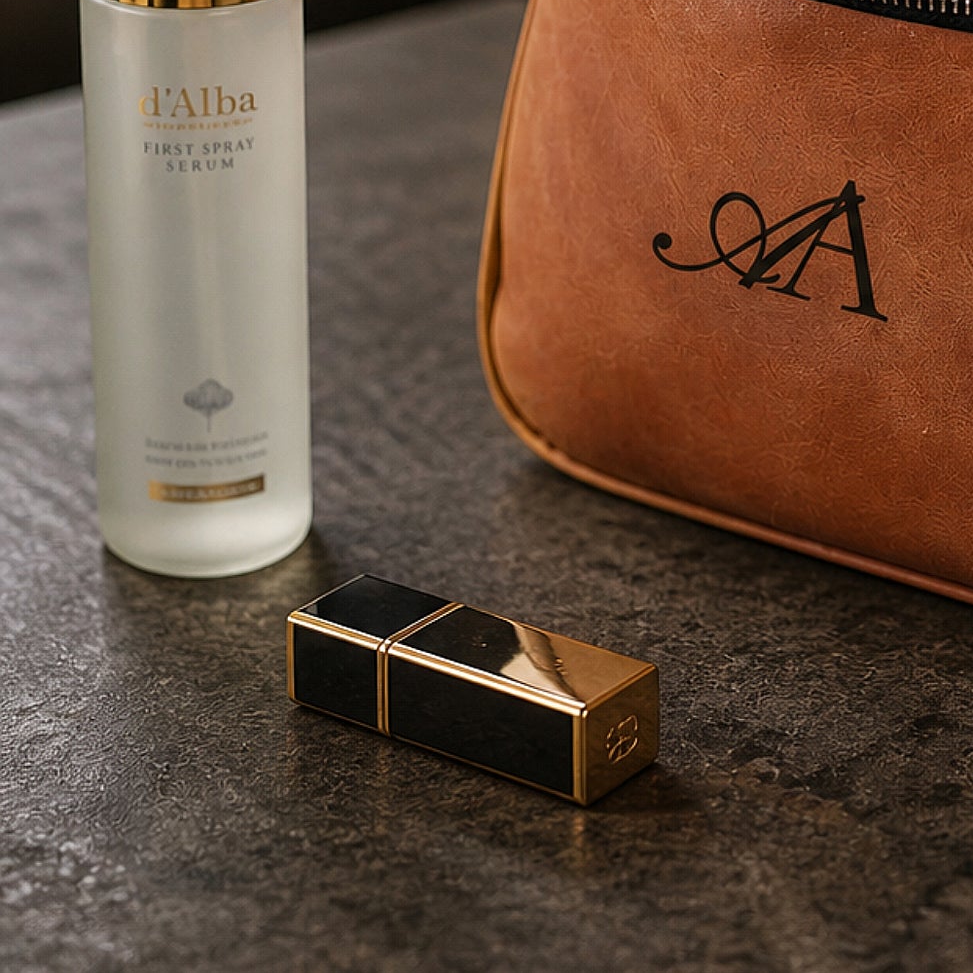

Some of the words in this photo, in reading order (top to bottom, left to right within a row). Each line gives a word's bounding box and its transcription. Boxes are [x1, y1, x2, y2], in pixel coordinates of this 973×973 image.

[138, 85, 258, 117] d'Alba
[144, 141, 194, 156] FIRST
[202, 136, 255, 156] SPRAY
[165, 157, 234, 173] SERUM
